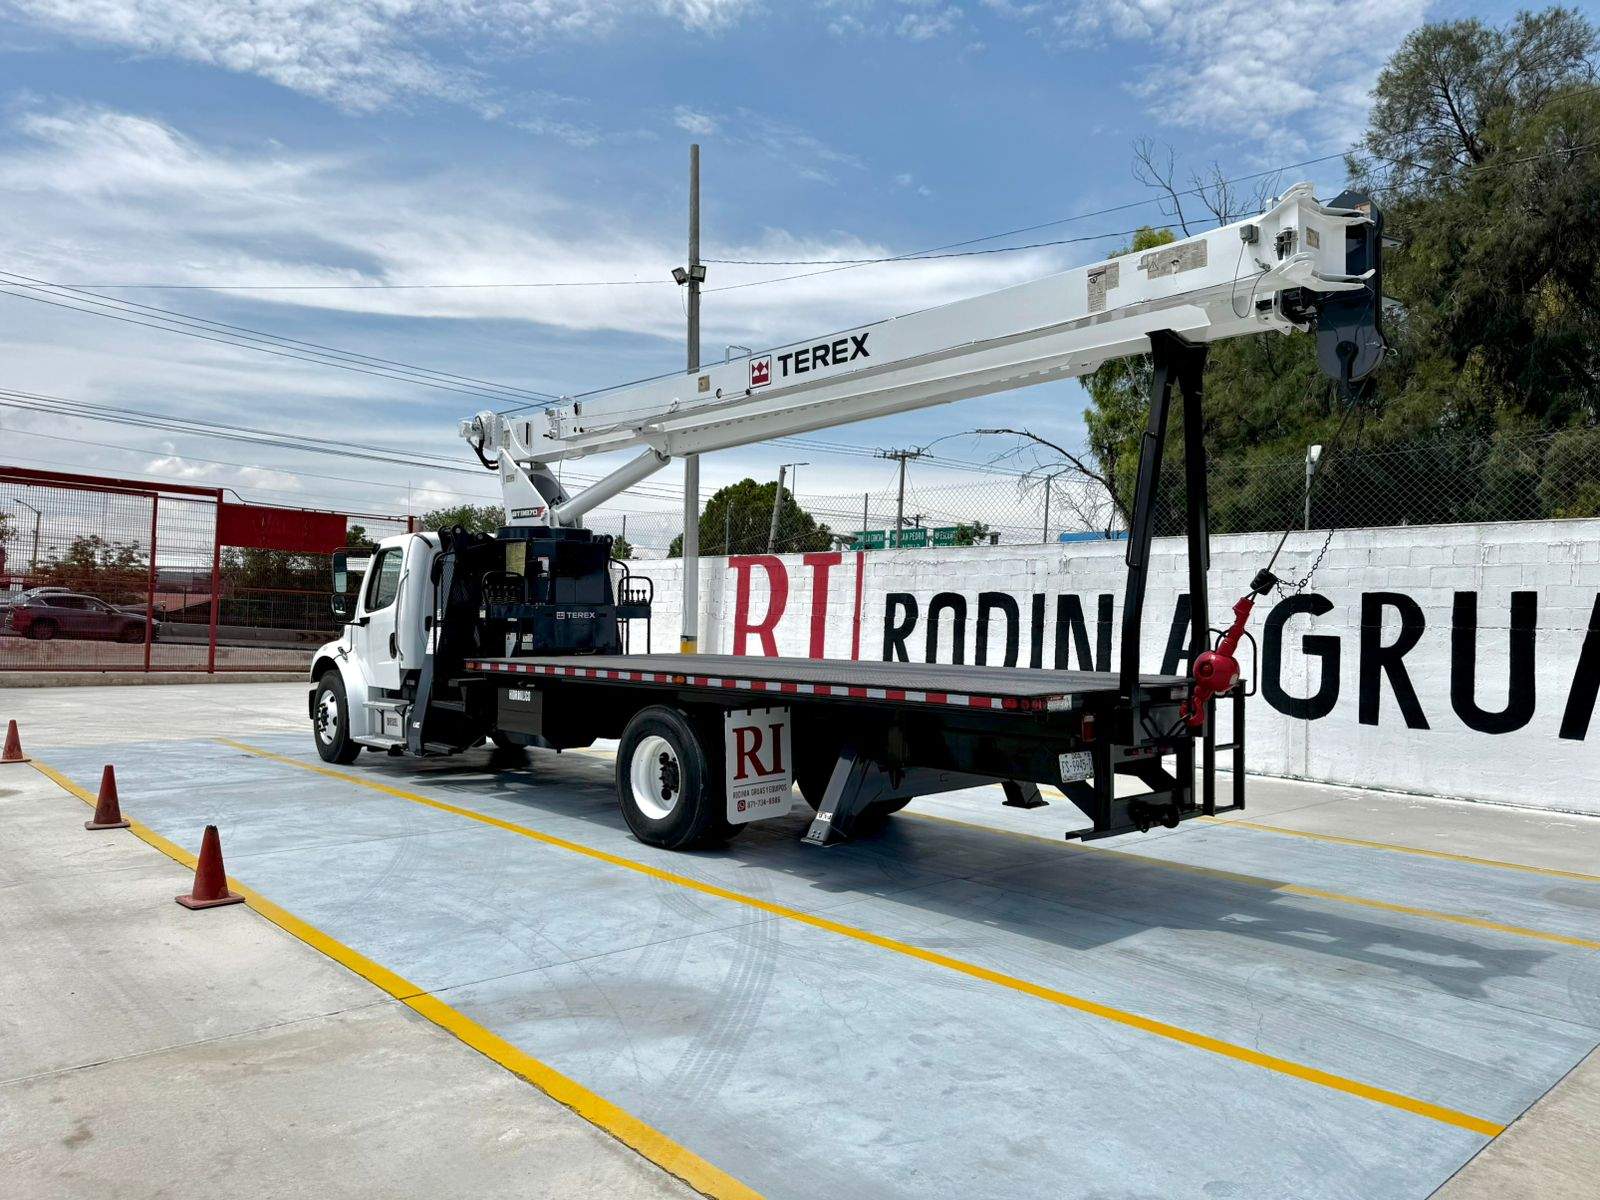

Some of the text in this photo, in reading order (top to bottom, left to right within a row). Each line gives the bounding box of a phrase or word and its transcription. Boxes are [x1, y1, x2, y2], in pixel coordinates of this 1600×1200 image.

[777, 332, 871, 377] TEREX
[566, 611, 596, 619] TEREX
[732, 723, 785, 780] RI
